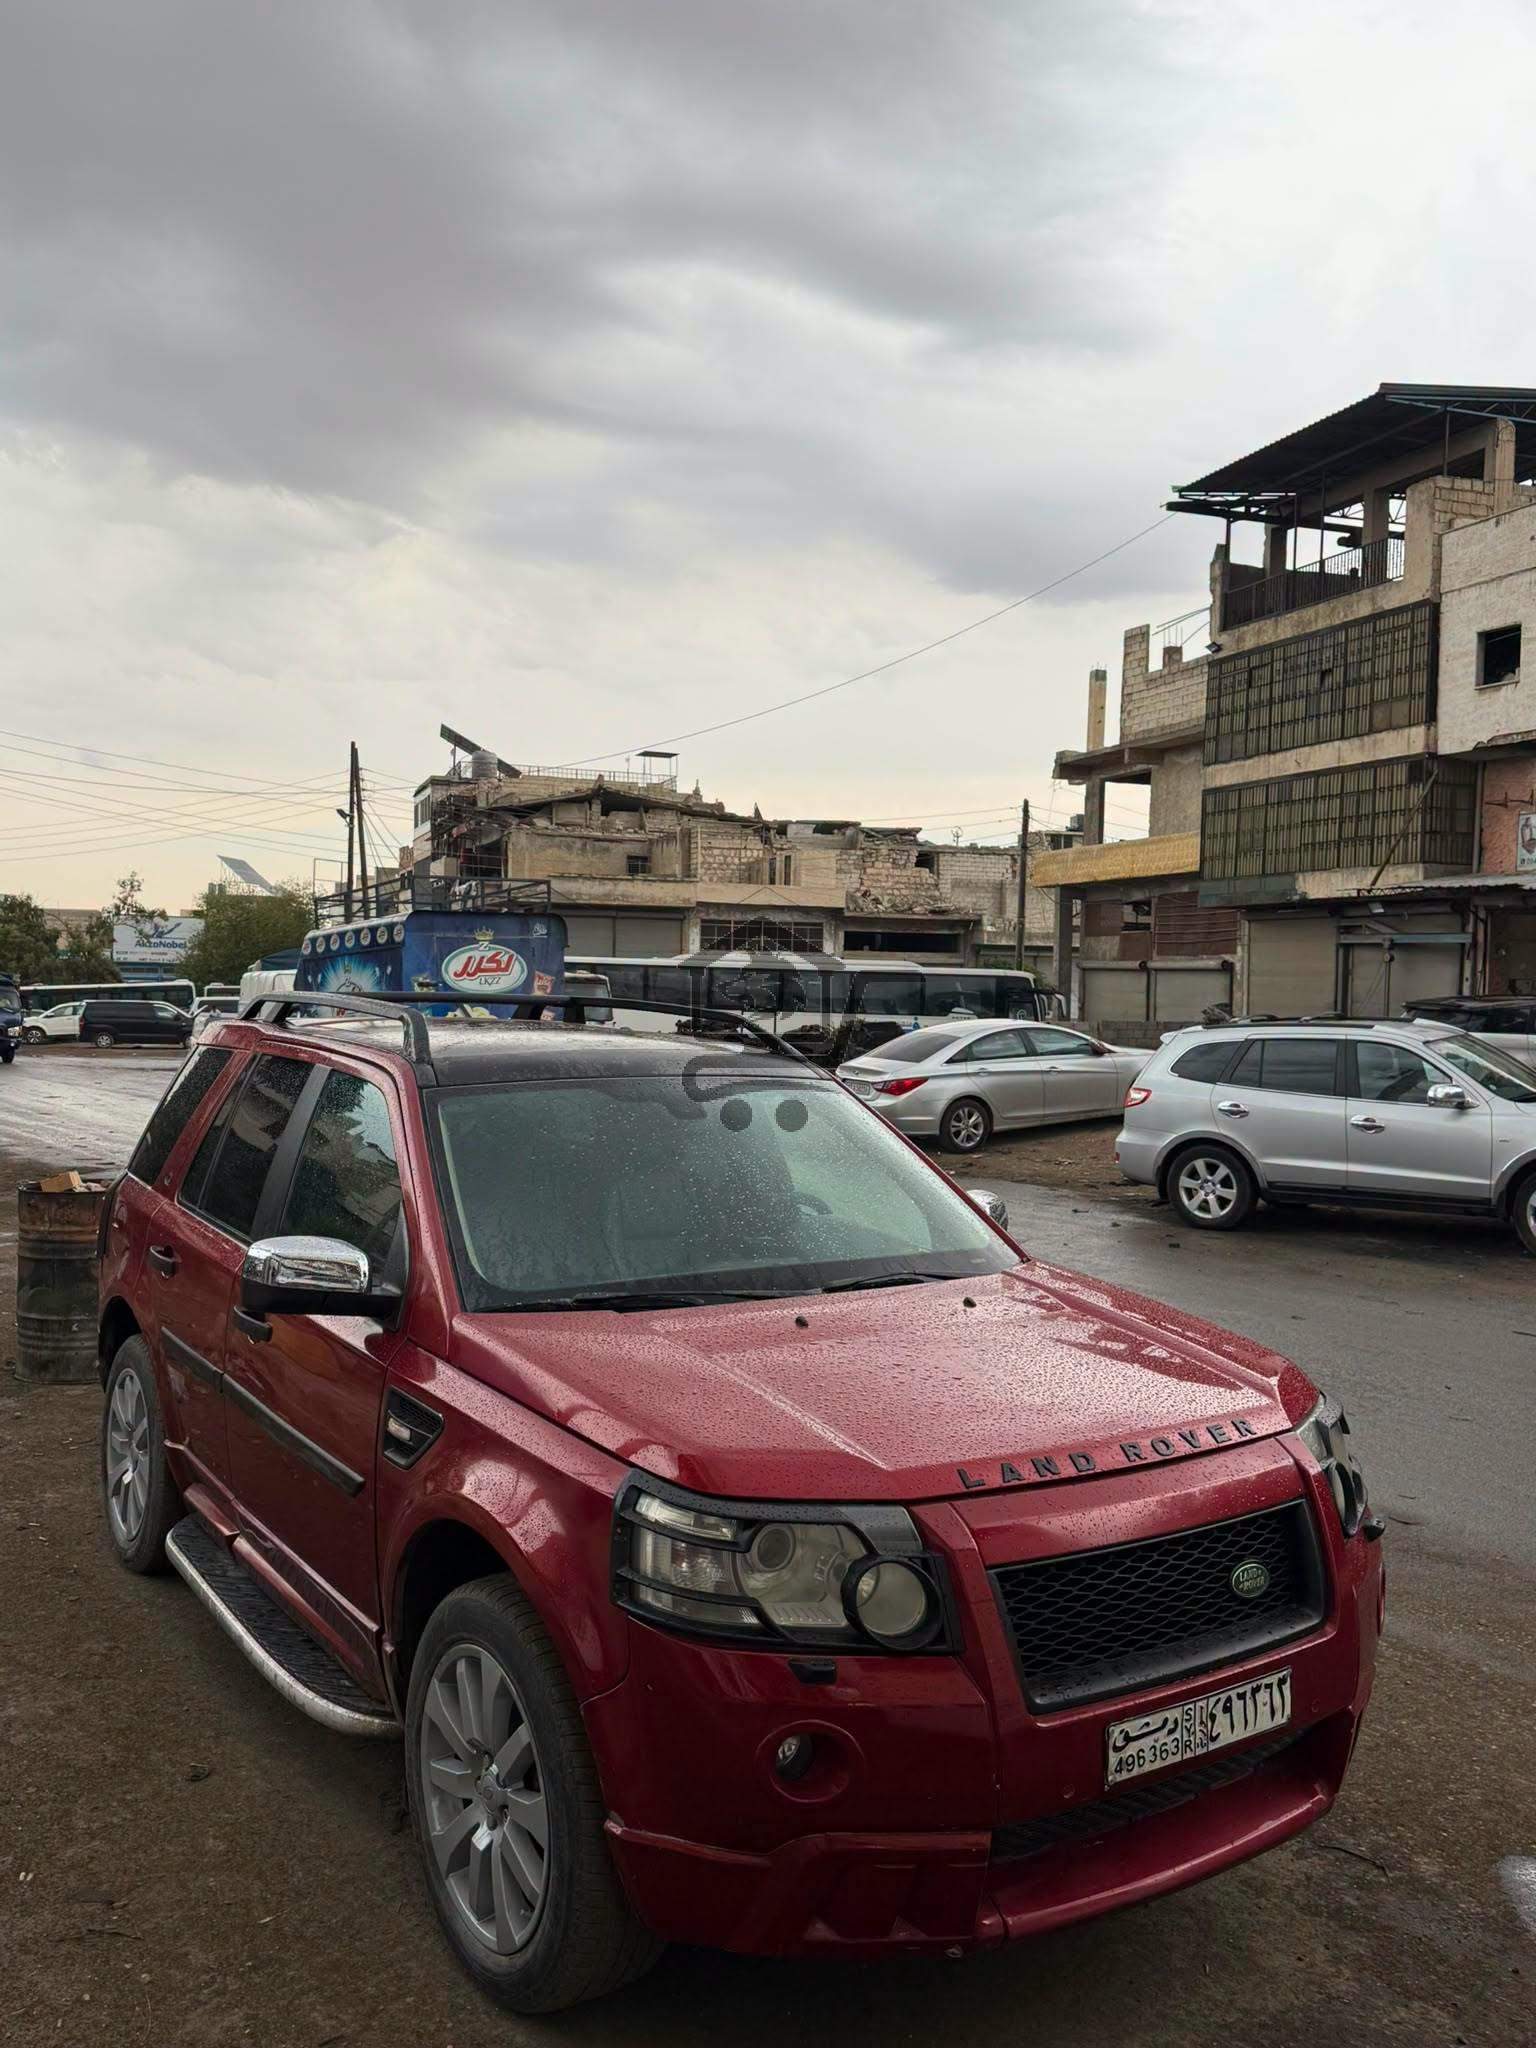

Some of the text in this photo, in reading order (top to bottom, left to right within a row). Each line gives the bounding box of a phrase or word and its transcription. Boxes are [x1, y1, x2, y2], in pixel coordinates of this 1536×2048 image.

[956, 1416, 1257, 1490] LAND ROVER
[1111, 1714, 1180, 1753] دمشق
[1184, 1707, 1195, 1755] SYR
[1114, 1737, 1181, 1776] 496363
